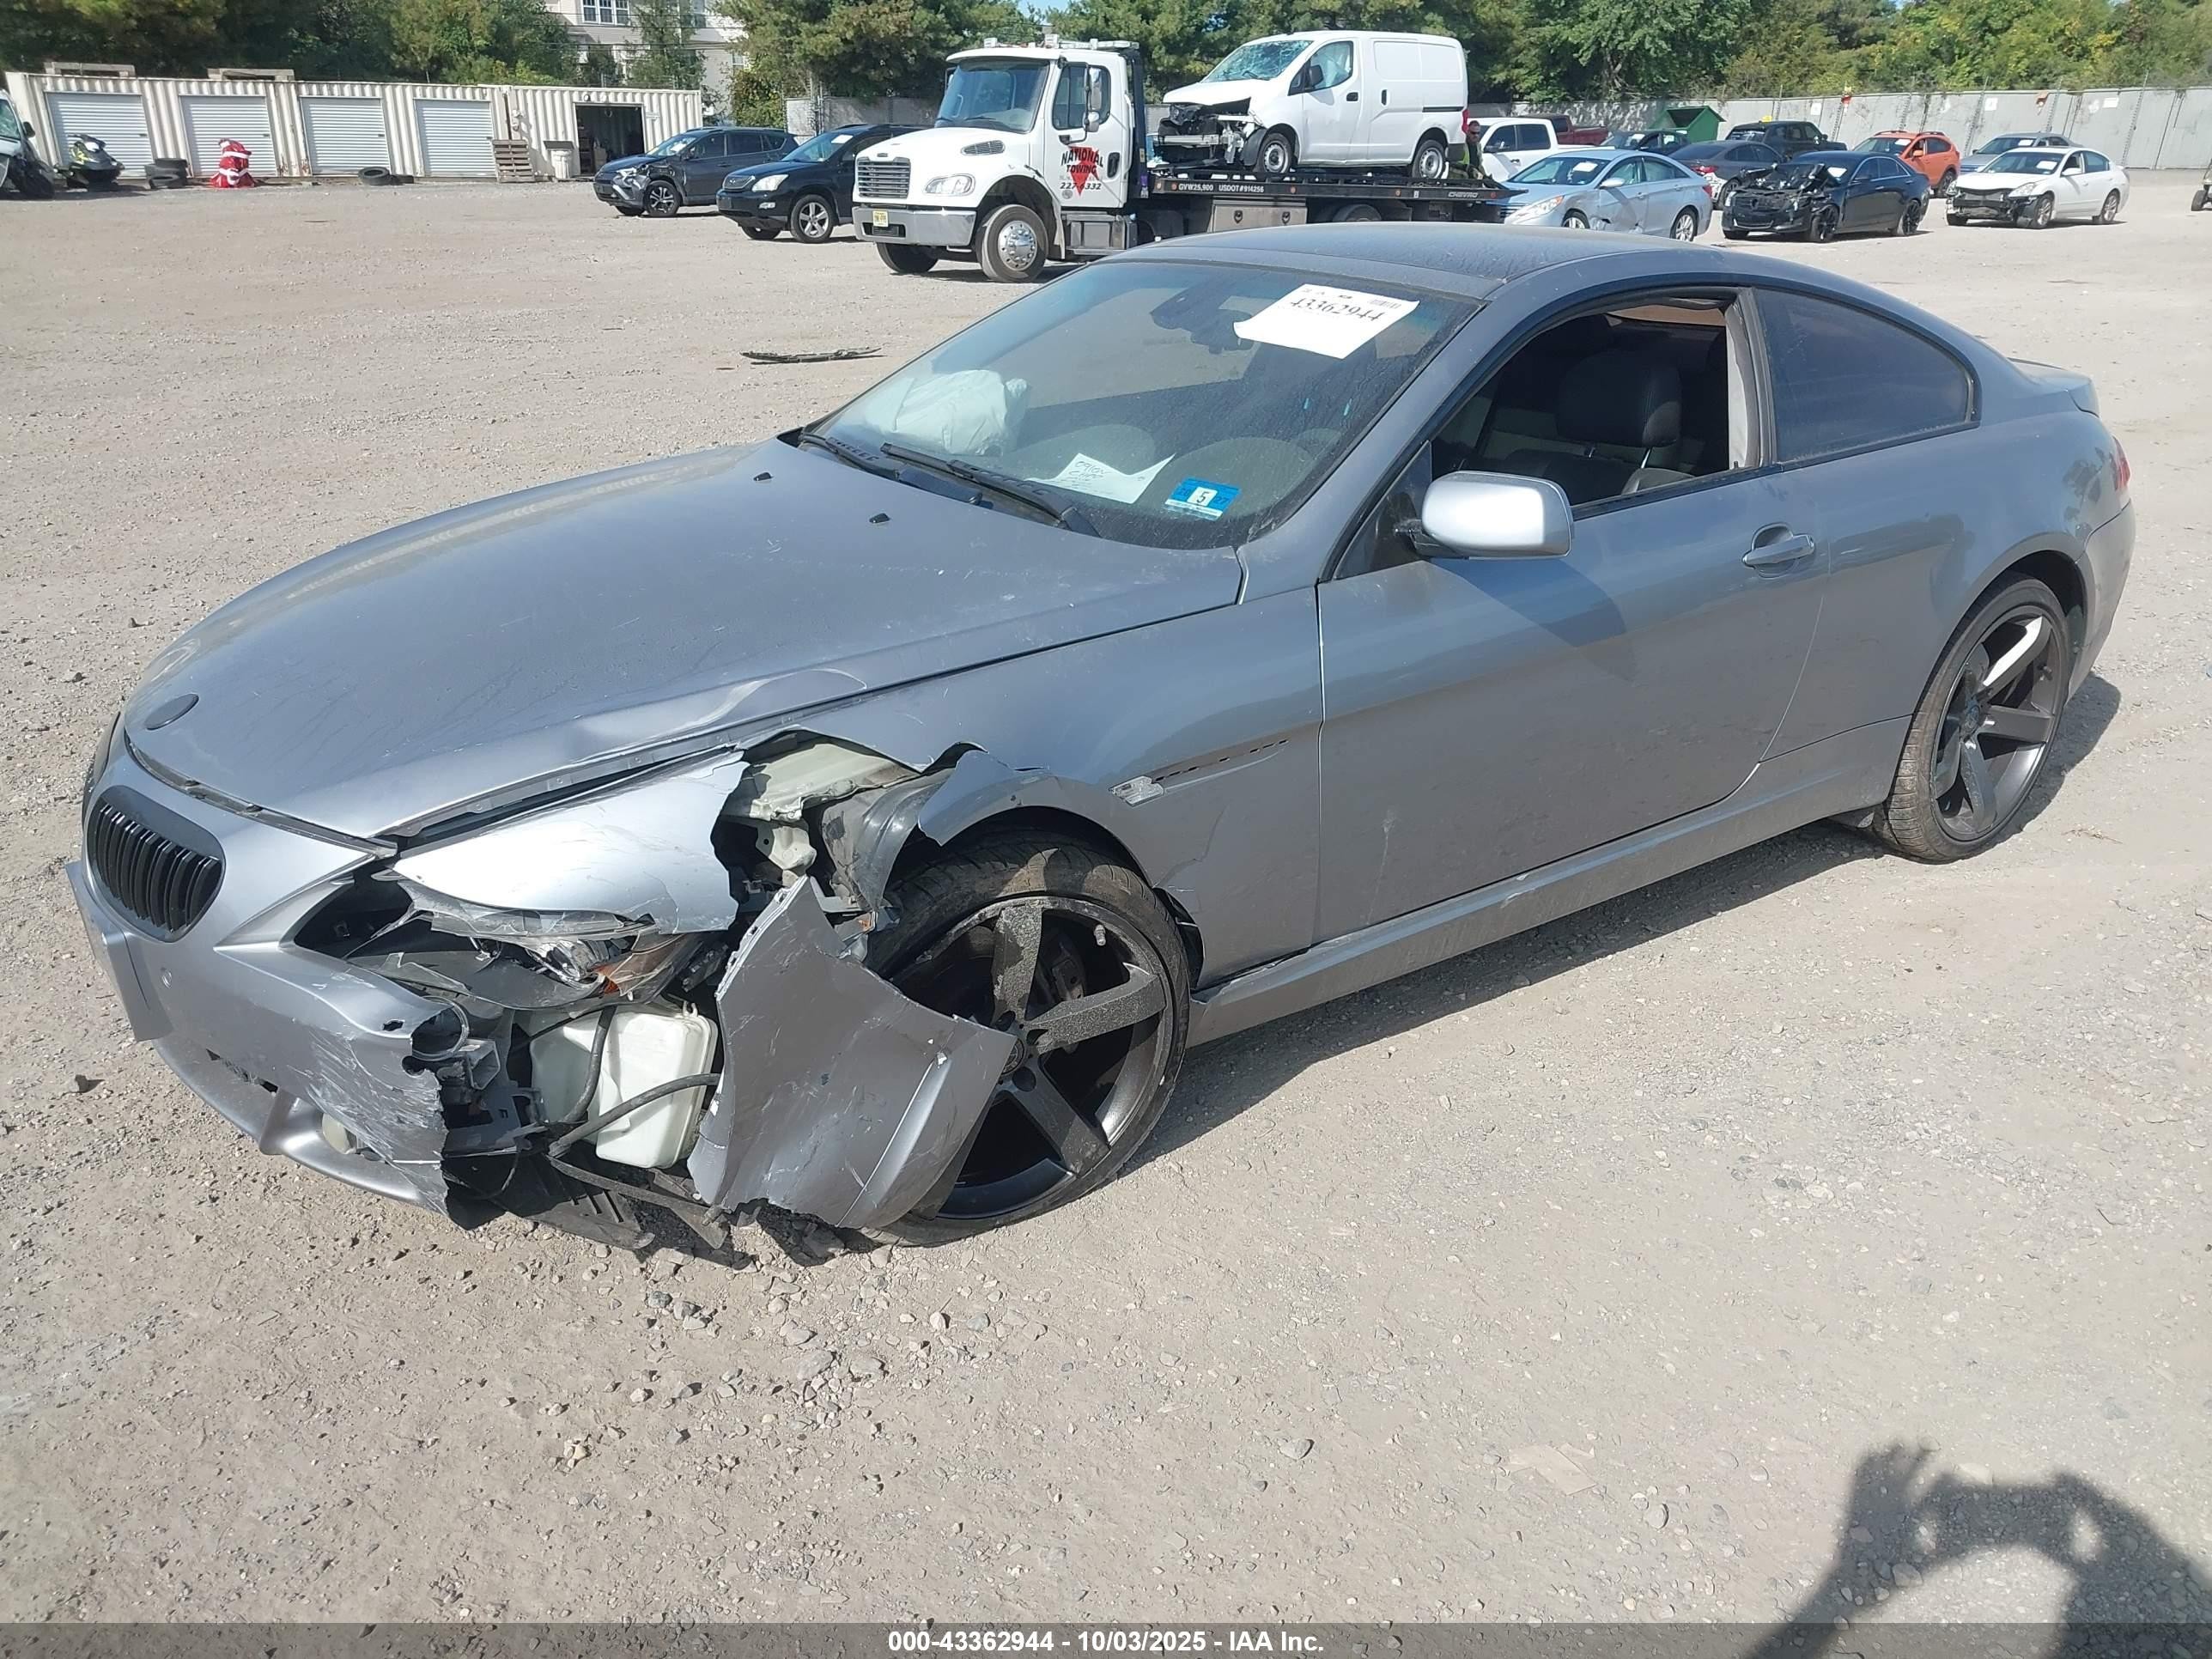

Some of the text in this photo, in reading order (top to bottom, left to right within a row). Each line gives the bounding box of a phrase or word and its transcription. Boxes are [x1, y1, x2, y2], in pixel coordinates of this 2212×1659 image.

[1060, 148, 1103, 168] NATIONAL
[1066, 165, 1097, 173] TOWING
[1290, 297, 1386, 322] 43362944
[1196, 490, 1210, 503] 5
